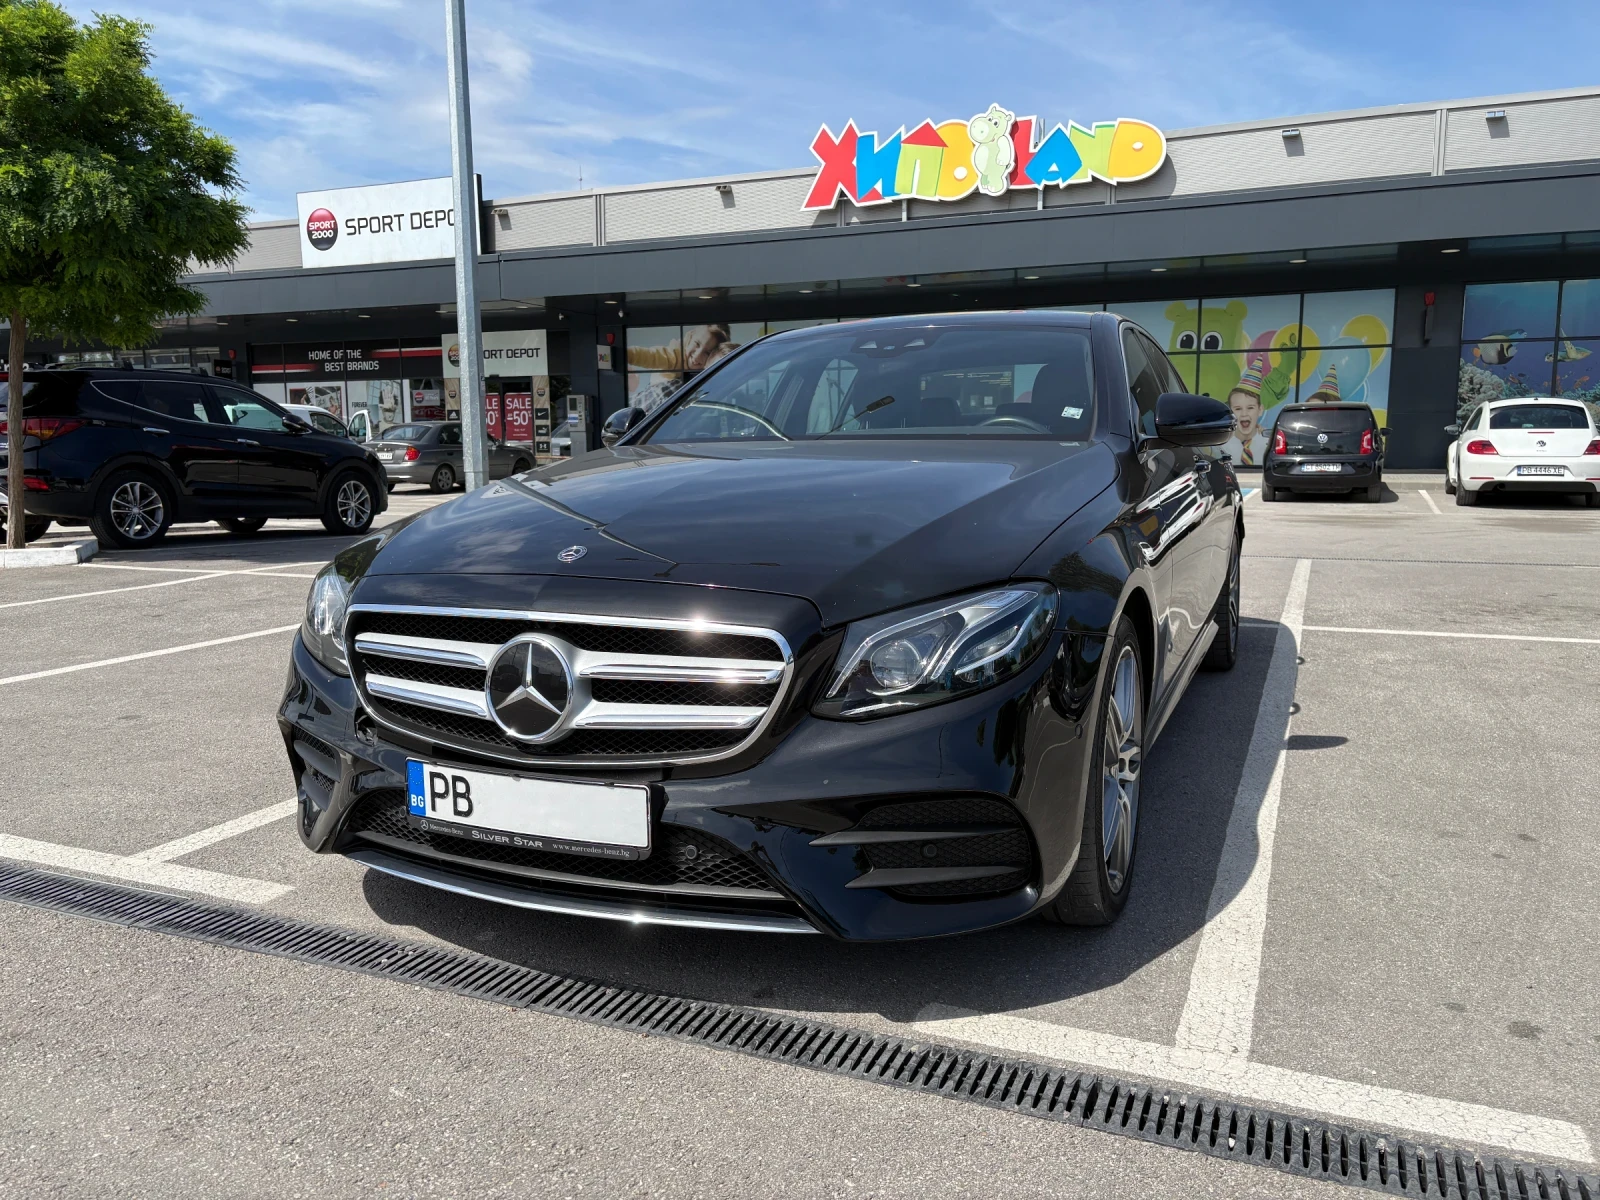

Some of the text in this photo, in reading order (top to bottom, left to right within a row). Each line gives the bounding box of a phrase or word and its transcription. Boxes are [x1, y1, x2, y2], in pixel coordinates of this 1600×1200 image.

[308, 220, 335, 230] SPORT
[345, 208, 455, 236] SPORT DEPO
[311, 230, 334, 239] 2000
[308, 349, 362, 360] HOME OF THE
[483, 347, 541, 359] ORT DEPOT
[324, 360, 380, 372] BEST BRANDS
[485, 398, 499, 409] LE
[506, 397, 532, 409] SALE
[1533, 466, 1552, 474] 4446
[1553, 466, 1563, 474] XE
[429, 771, 474, 818] PB
[411, 794, 424, 808] BG
[552, 842, 630, 858] www.mercedes-benz.bg
